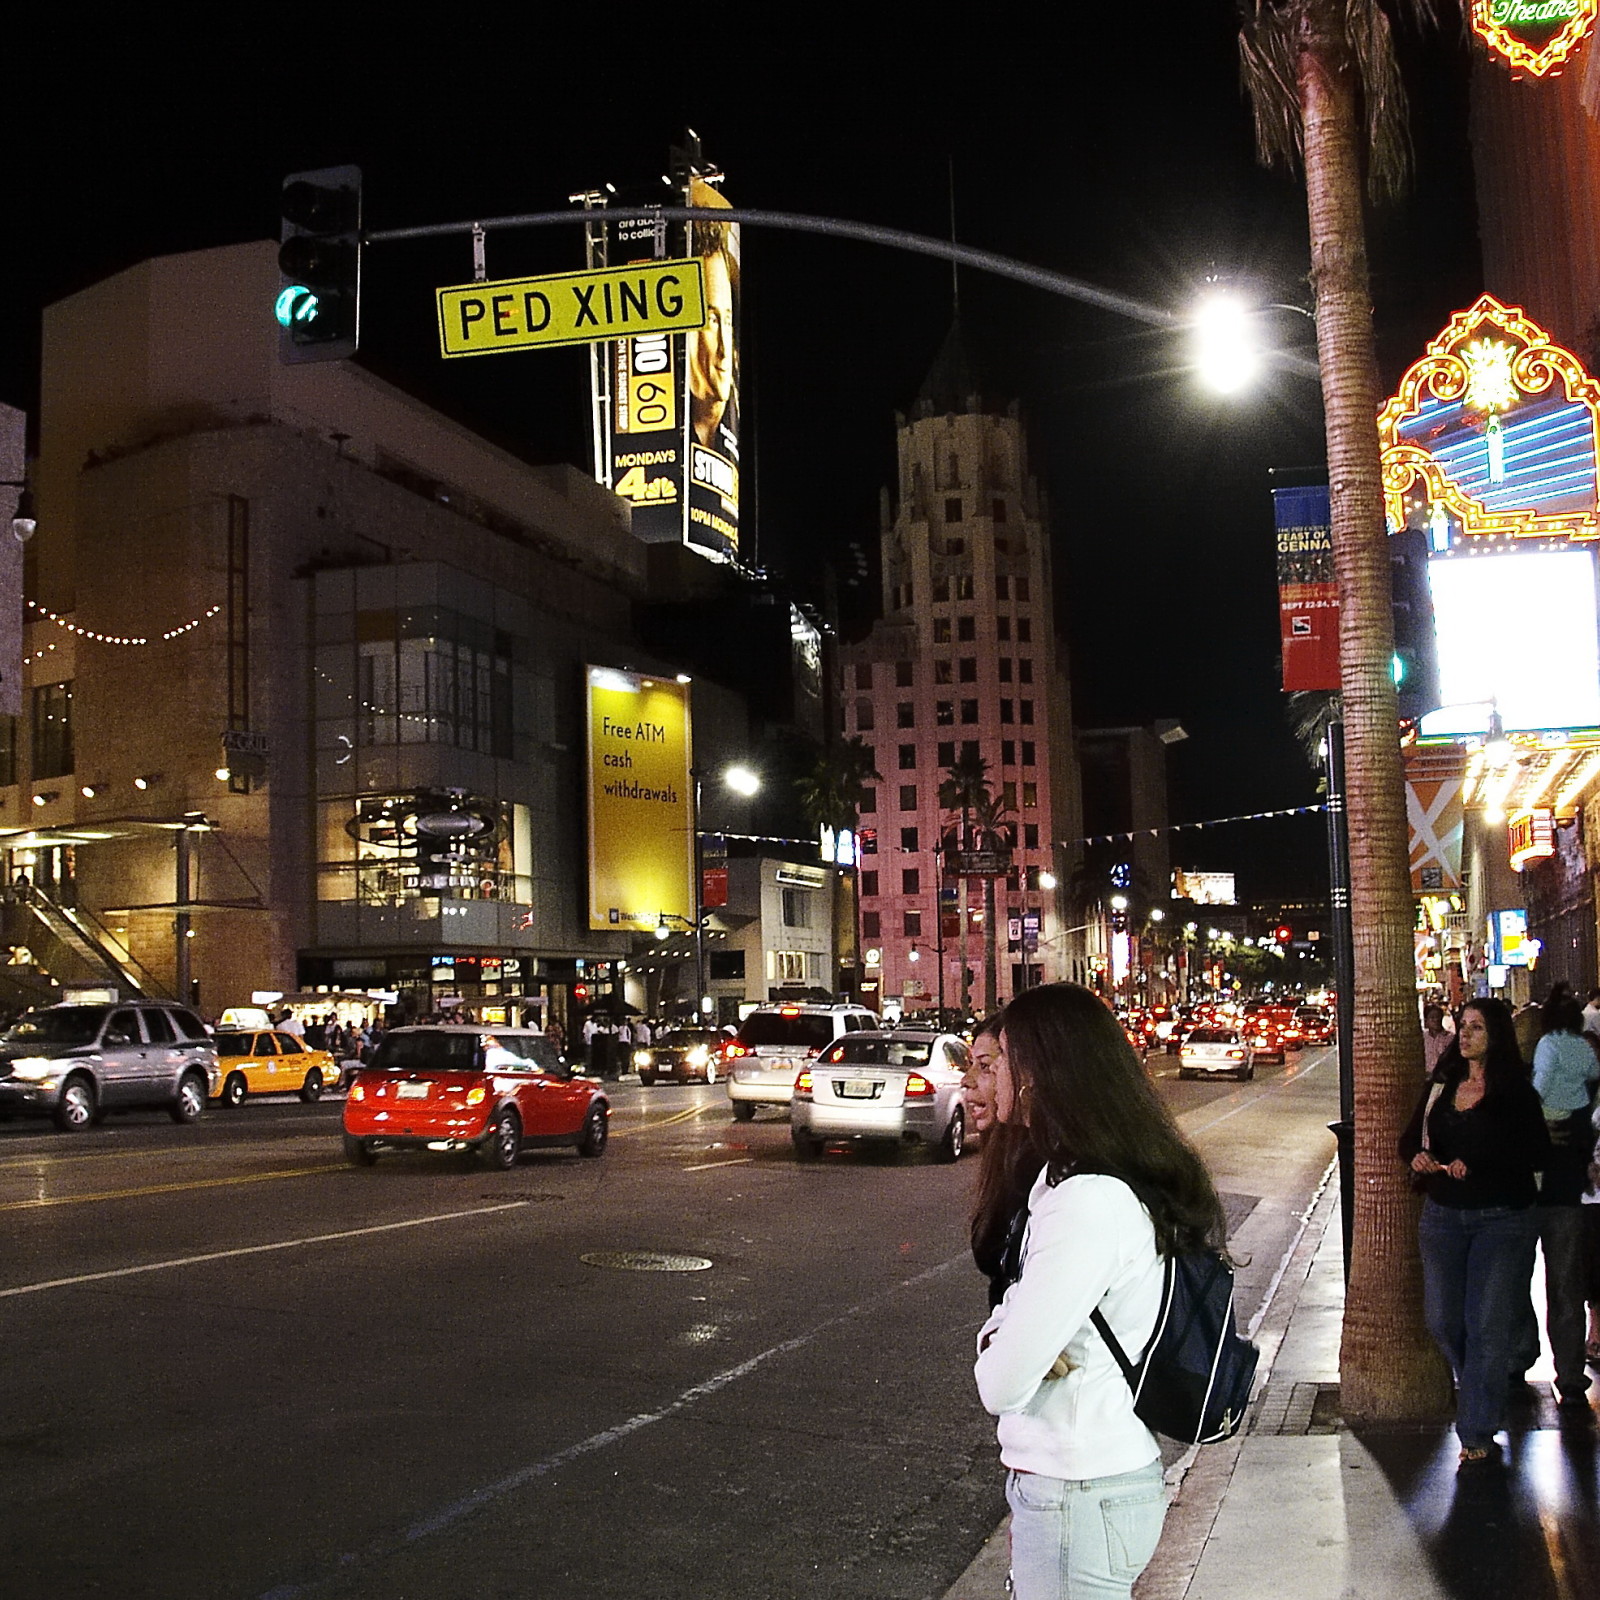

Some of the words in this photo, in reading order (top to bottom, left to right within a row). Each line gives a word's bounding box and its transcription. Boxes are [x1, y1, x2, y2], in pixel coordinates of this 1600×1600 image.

[619, 220, 635, 229] are
[619, 231, 629, 241] to
[460, 291, 550, 341] PED
[572, 275, 683, 328] XING
[617, 354, 628, 371] THE
[618, 371, 628, 404] SUNSET
[636, 382, 667, 424] 60
[615, 449, 676, 468] MONDAYS
[615, 466, 648, 501] 4
[690, 507, 711, 526] 10PM
[1277, 531, 1310, 542] FEAST
[1313, 530, 1327, 540] OF
[1281, 602, 1303, 610] SEPT
[603, 716, 632, 739] Free
[635, 722, 665, 744] ATM
[603, 749, 633, 768] cash
[603, 779, 678, 803] withdrawals
